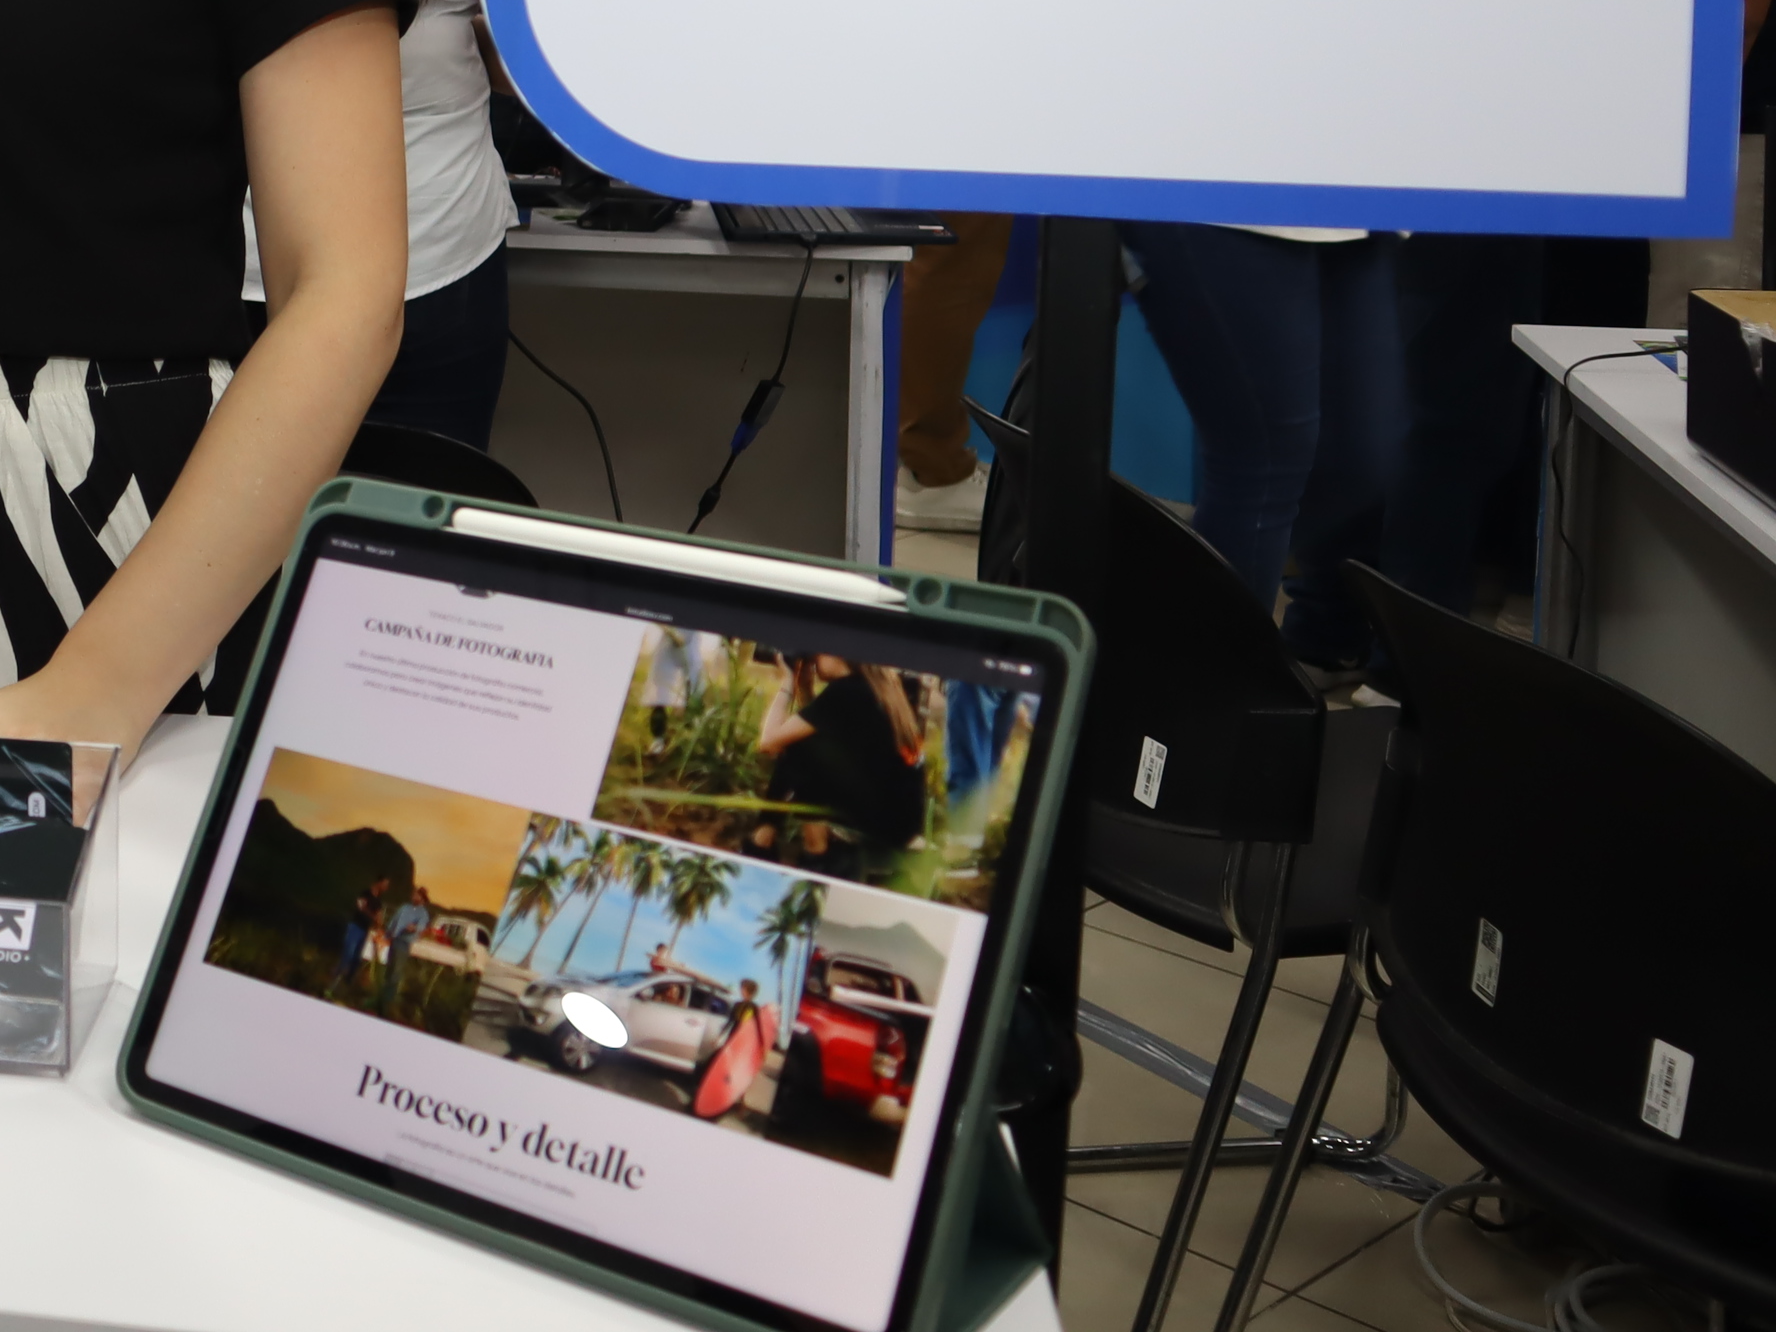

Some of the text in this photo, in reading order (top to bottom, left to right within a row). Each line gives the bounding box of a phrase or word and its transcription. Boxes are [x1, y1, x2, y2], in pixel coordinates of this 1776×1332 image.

[364, 617, 432, 645] CAMPAÑA
[433, 633, 458, 649] DE
[356, 1064, 489, 1139] Proceso
[489, 1119, 517, 1153] y
[521, 1123, 646, 1191] detalle
